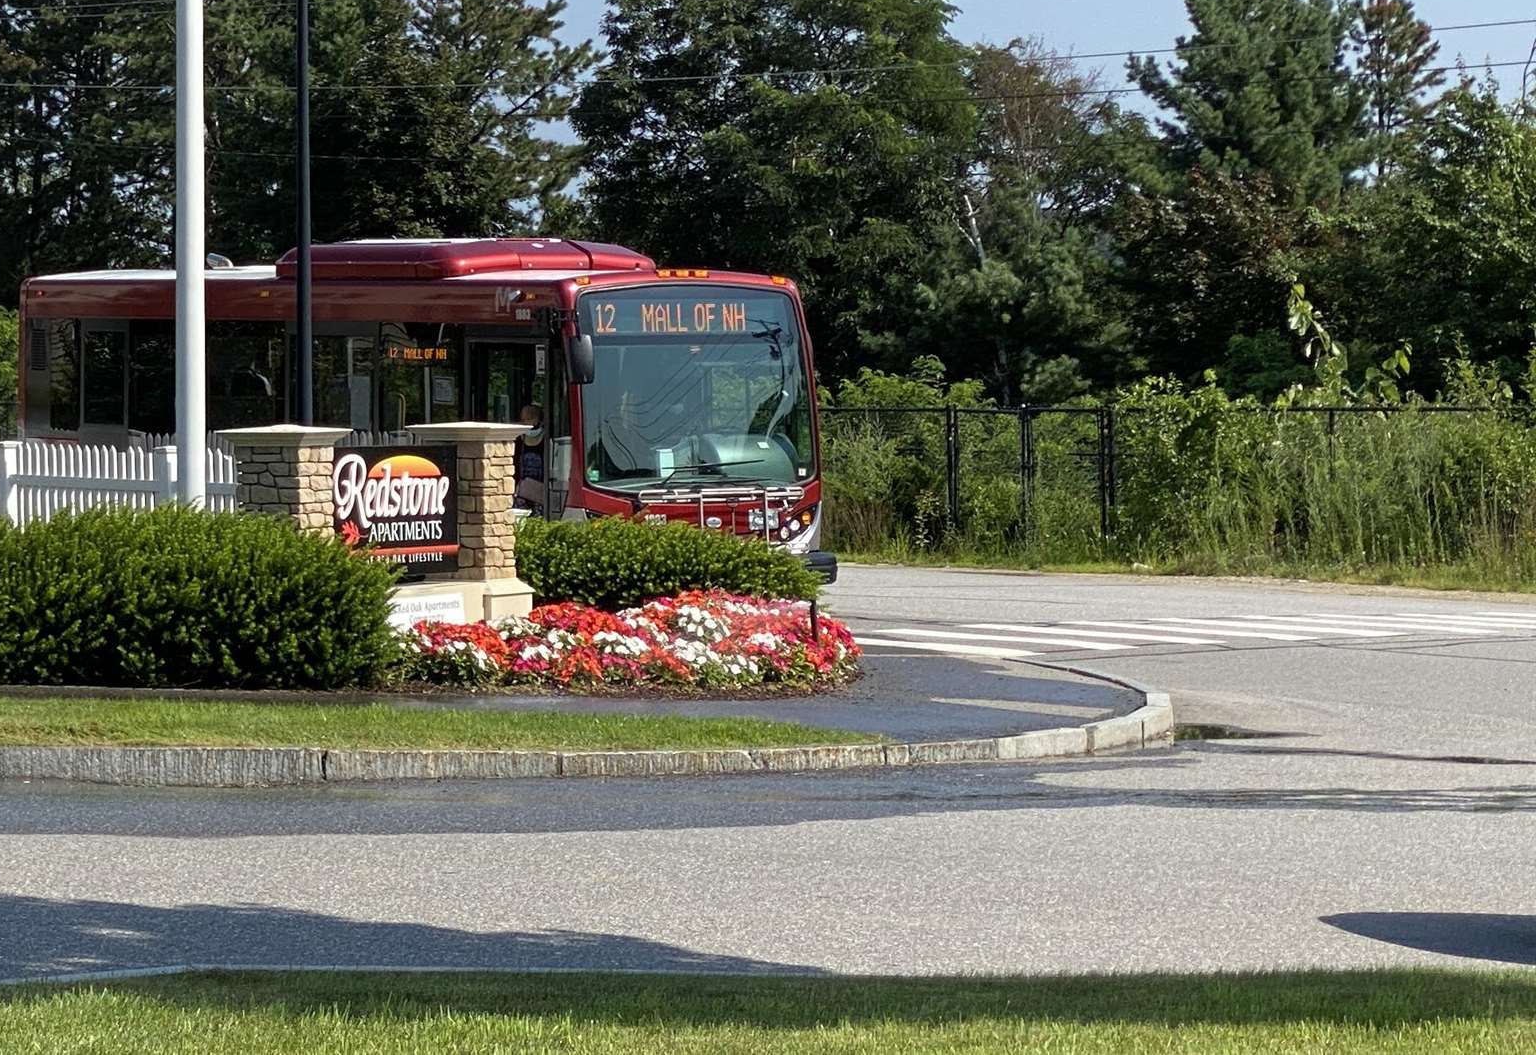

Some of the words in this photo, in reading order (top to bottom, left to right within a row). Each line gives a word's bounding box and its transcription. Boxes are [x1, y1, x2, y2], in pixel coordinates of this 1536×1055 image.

[595, 303, 616, 333] 12
[641, 303, 688, 333] MALL
[694, 303, 715, 332] OF
[722, 302, 746, 332] NH
[404, 348, 423, 359] MALL
[424, 348, 434, 359] OF
[333, 453, 450, 528] Redstone
[368, 520, 443, 543] APARTMENTS
[408, 552, 443, 563] LIFESTYLE
[425, 600, 460, 613] Apartments
